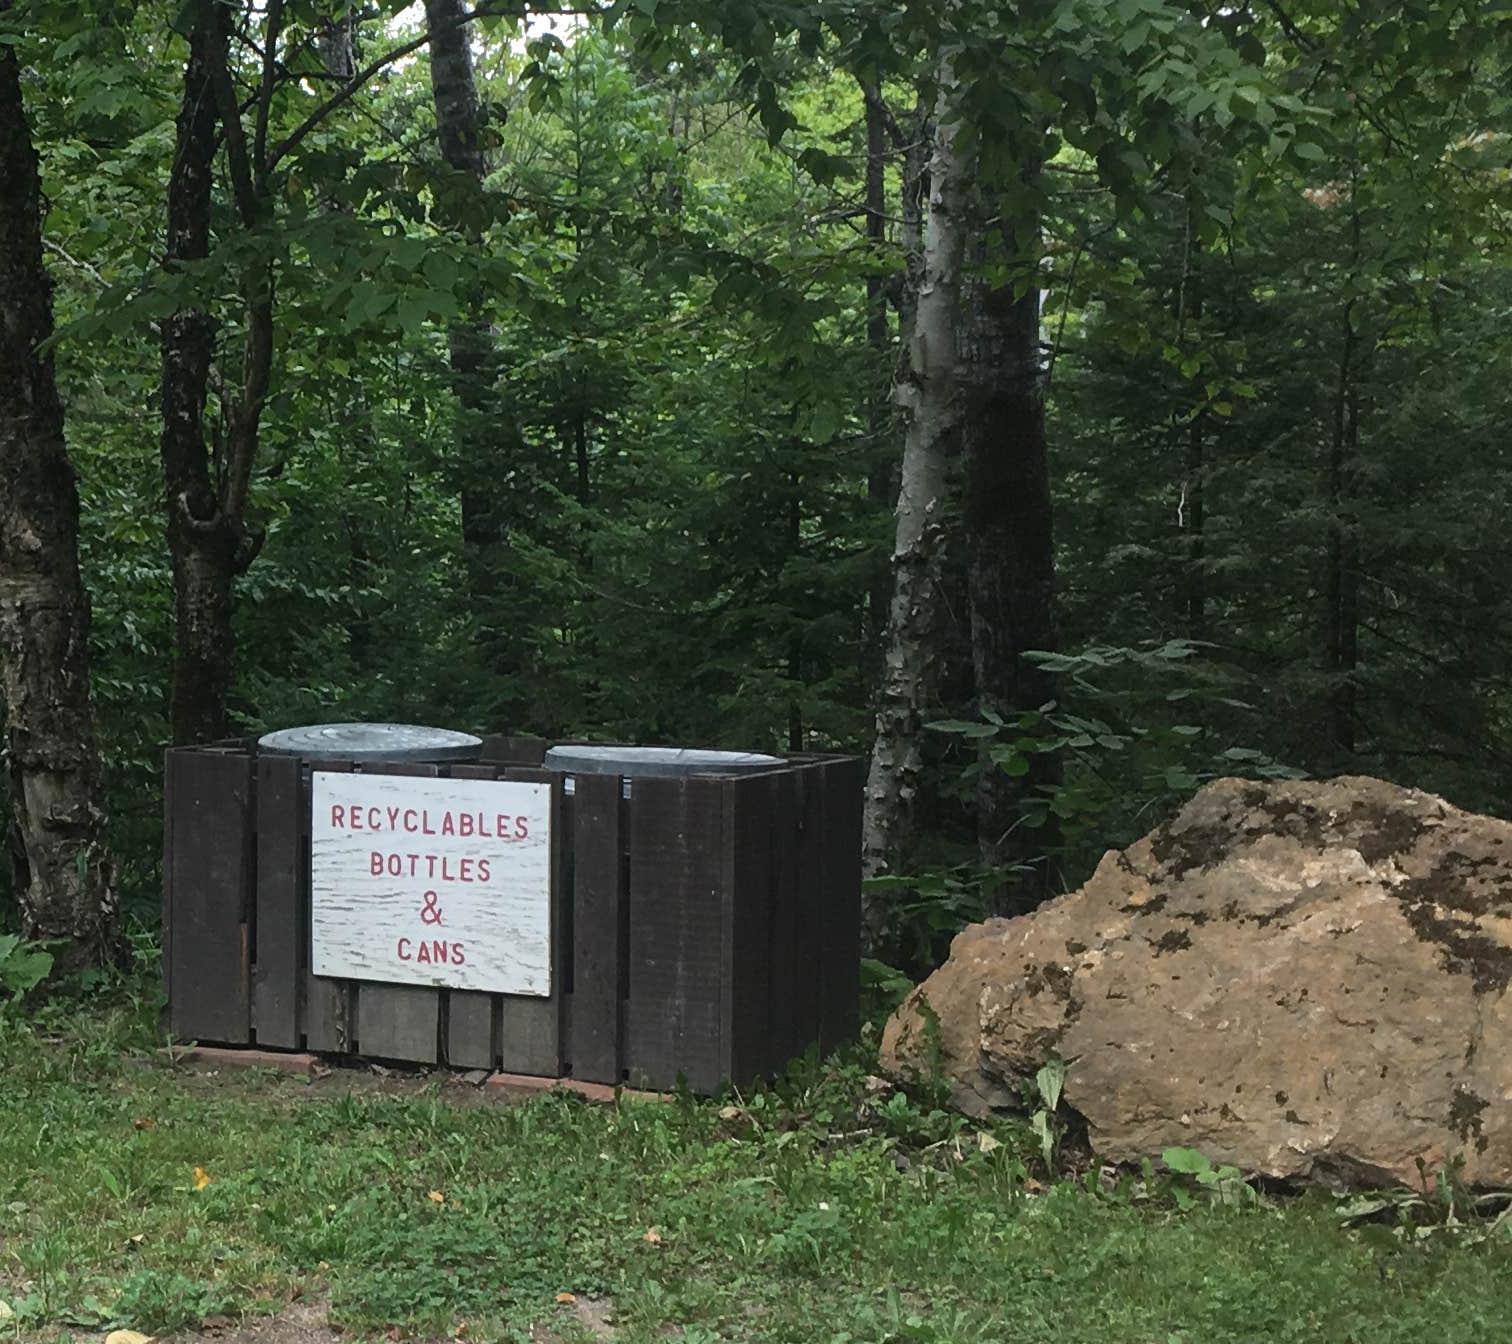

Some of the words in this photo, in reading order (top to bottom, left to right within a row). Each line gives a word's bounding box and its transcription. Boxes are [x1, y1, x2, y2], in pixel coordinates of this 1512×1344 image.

[331, 805, 529, 839] RECYCLABLES
[370, 851, 491, 882] BOTTLES
[420, 890, 442, 926] &
[397, 938, 465, 965] CANS
